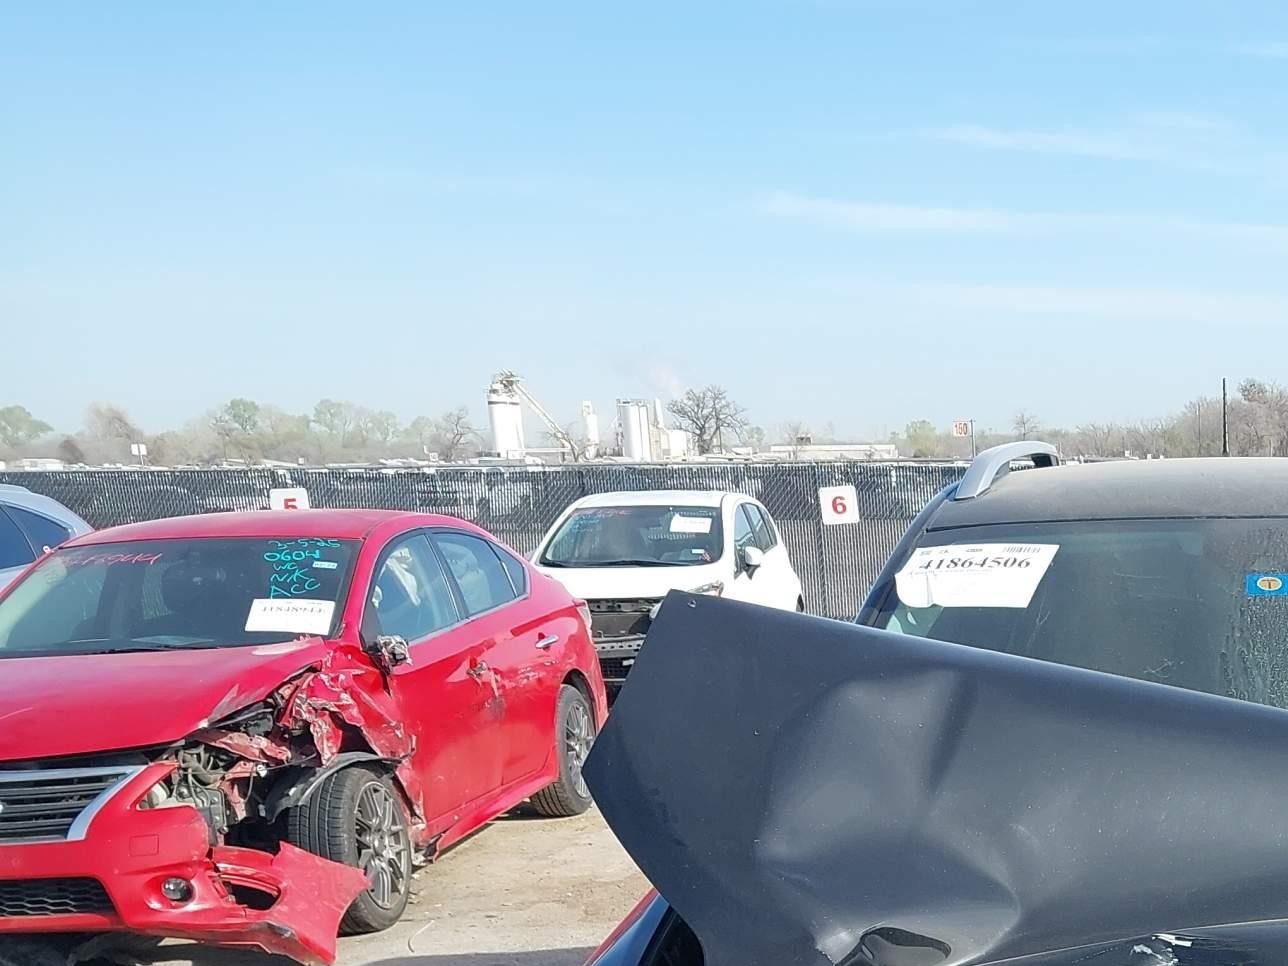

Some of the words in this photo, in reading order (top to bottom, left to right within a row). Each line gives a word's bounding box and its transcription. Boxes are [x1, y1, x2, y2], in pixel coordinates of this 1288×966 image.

[283, 498, 298, 509] 5
[831, 495, 847, 514] 6
[263, 549, 321, 560] 0604
[918, 556, 1032, 570] 41864506
[270, 578, 321, 600] ACC
